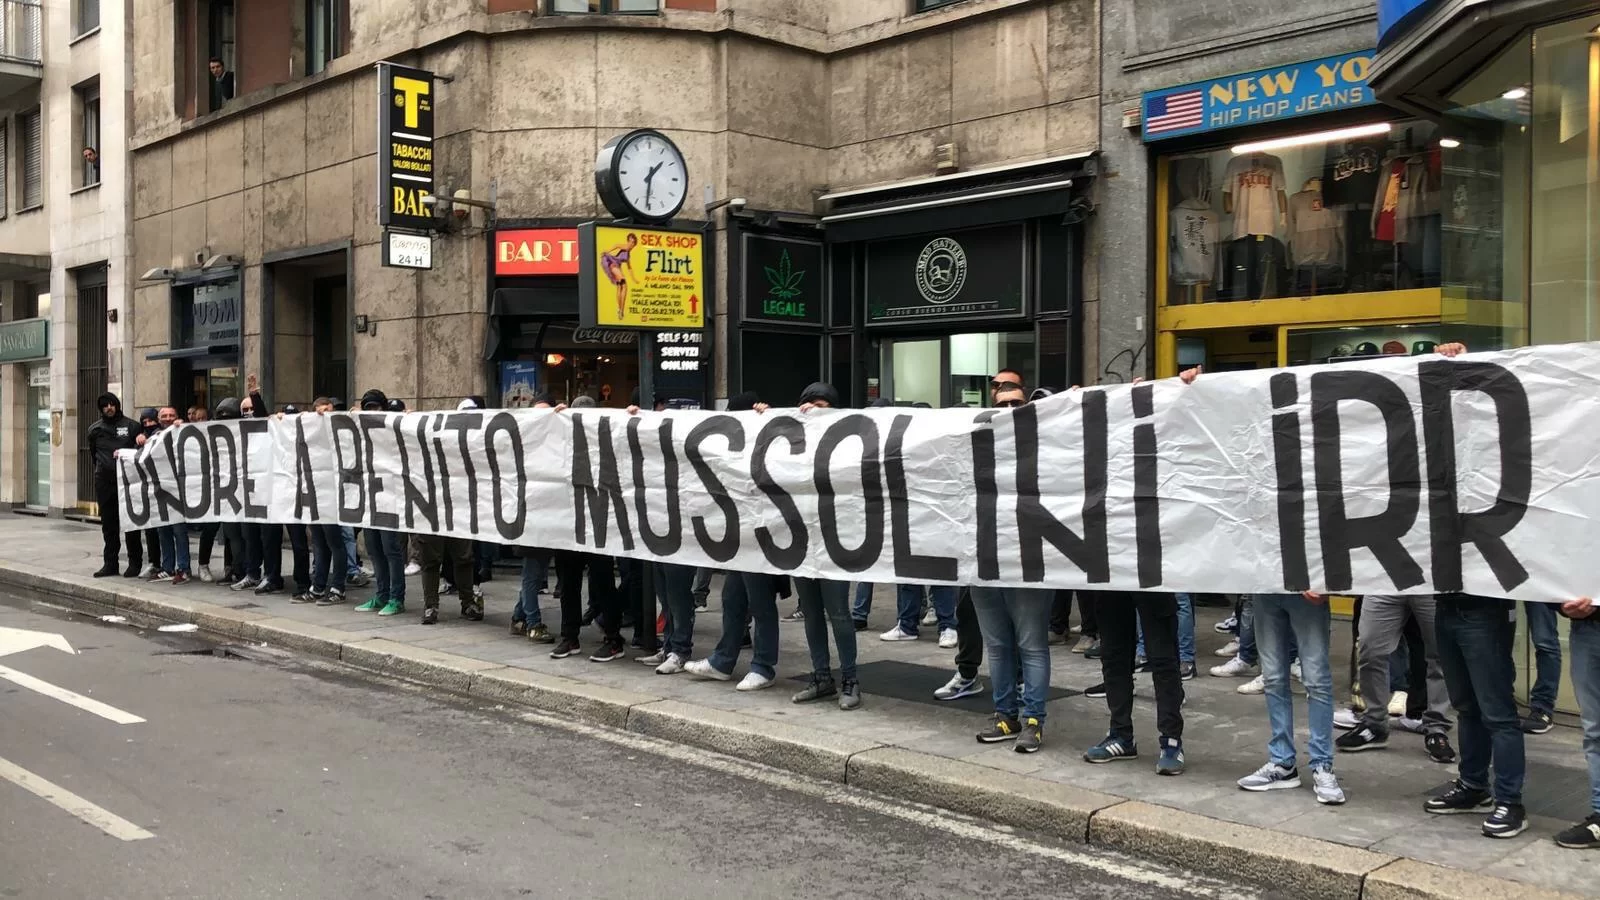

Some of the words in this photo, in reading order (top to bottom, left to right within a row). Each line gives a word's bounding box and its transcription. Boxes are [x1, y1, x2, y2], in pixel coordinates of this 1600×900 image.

[1208, 69, 1299, 107] NEW
[393, 76, 430, 128] T
[1210, 109, 1241, 127] HIP
[1248, 101, 1289, 119] HOP
[1295, 87, 1363, 112] JEANS
[392, 143, 431, 160] TABACCHI
[393, 186, 432, 217] BAR
[641, 234, 662, 247] SEX
[666, 235, 697, 248] SHOP
[398, 254, 411, 264] 24
[415, 256, 423, 266] H
[499, 240, 552, 263] BAR
[557, 240, 579, 262] T
[645, 250, 693, 275] Flirt
[633, 298, 648, 306] VIALE
[763, 299, 806, 317] LEGALE
[915, 306, 946, 314] BUENOS
[951, 304, 976, 312] AIRES
[657, 332, 680, 342] SELF
[682, 333, 703, 343] 24H
[661, 346, 699, 357] SERVIZI
[661, 360, 699, 370] ONLINE
[294, 415, 319, 522] A
